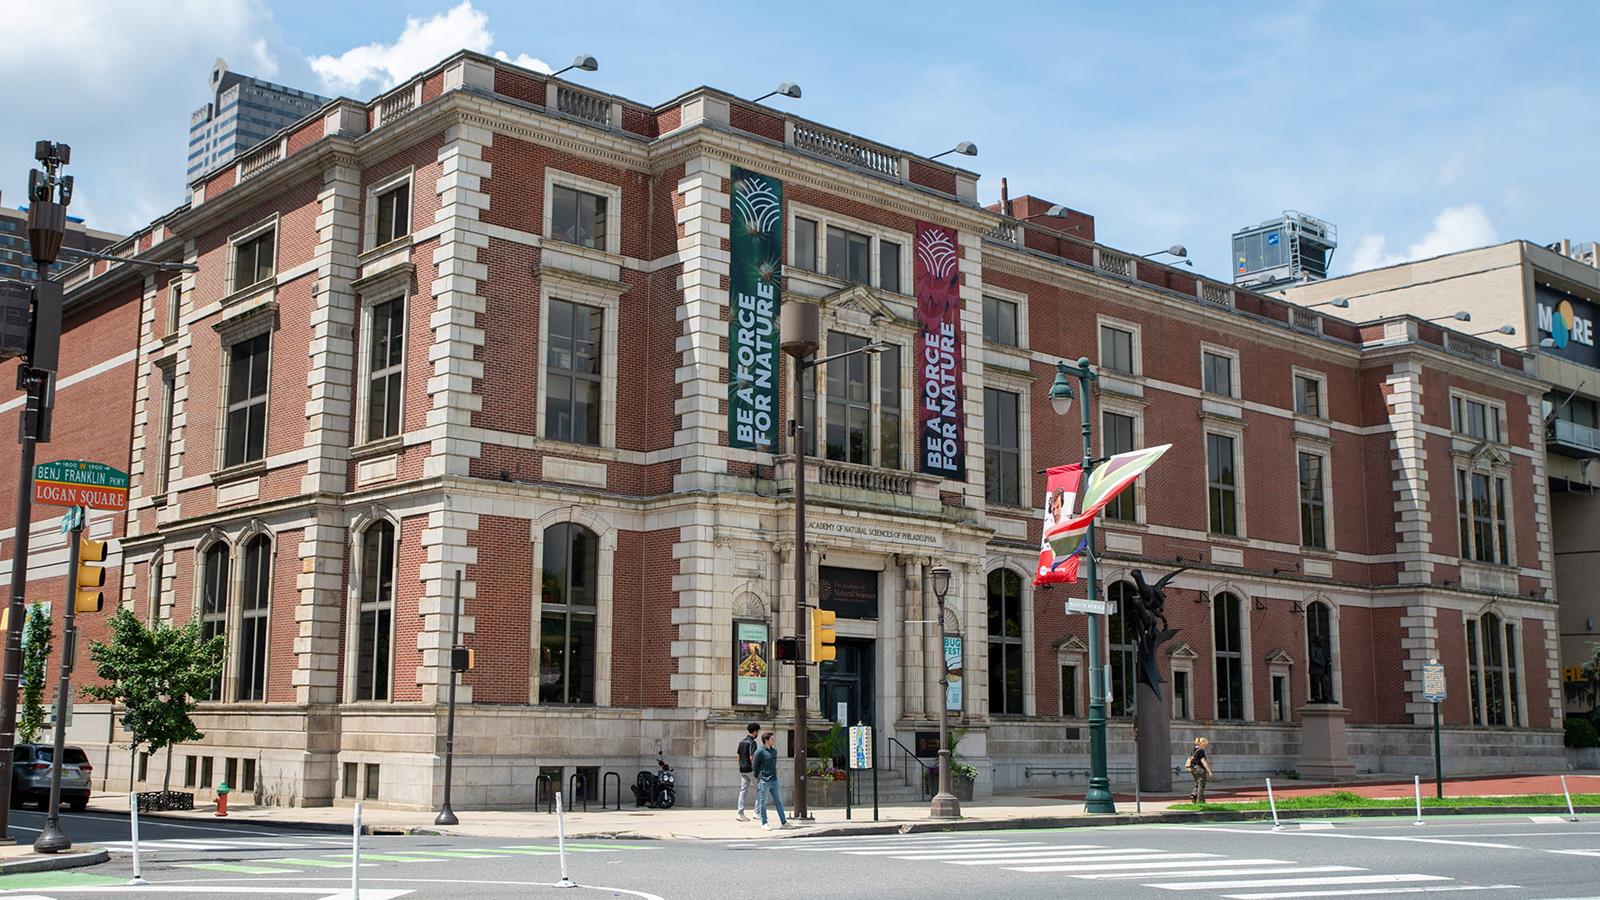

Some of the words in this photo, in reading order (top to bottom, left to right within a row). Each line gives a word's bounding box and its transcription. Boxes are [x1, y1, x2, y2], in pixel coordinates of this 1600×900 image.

[737, 293, 755, 381] FORCE
[755, 282, 774, 388] NATURE
[925, 332, 941, 412] FORCE
[941, 322, 956, 417] NATURE
[737, 388, 753, 405] A
[737, 408, 753, 443] BE
[755, 394, 771, 445] FOR
[927, 417, 941, 434] A
[927, 436, 942, 468] BE
[942, 423, 957, 471] FOR
[38, 467, 60, 480] BENJ
[64, 469, 106, 484] FRANKLIN
[109, 477, 125, 486] PKWY
[36, 486, 76, 501] LOGAN
[80, 490, 124, 507] SQUARE
[809, 521, 835, 531] ACADEMY
[836, 524, 844, 532] OF
[844, 525, 867, 535] NATURAL
[868, 528, 894, 538] SCIENCES
[894, 530, 901, 539] OF
[901, 533, 937, 543] PHILADELPHIA
[944, 638, 960, 647] BUG
[944, 647, 960, 655] FEST
